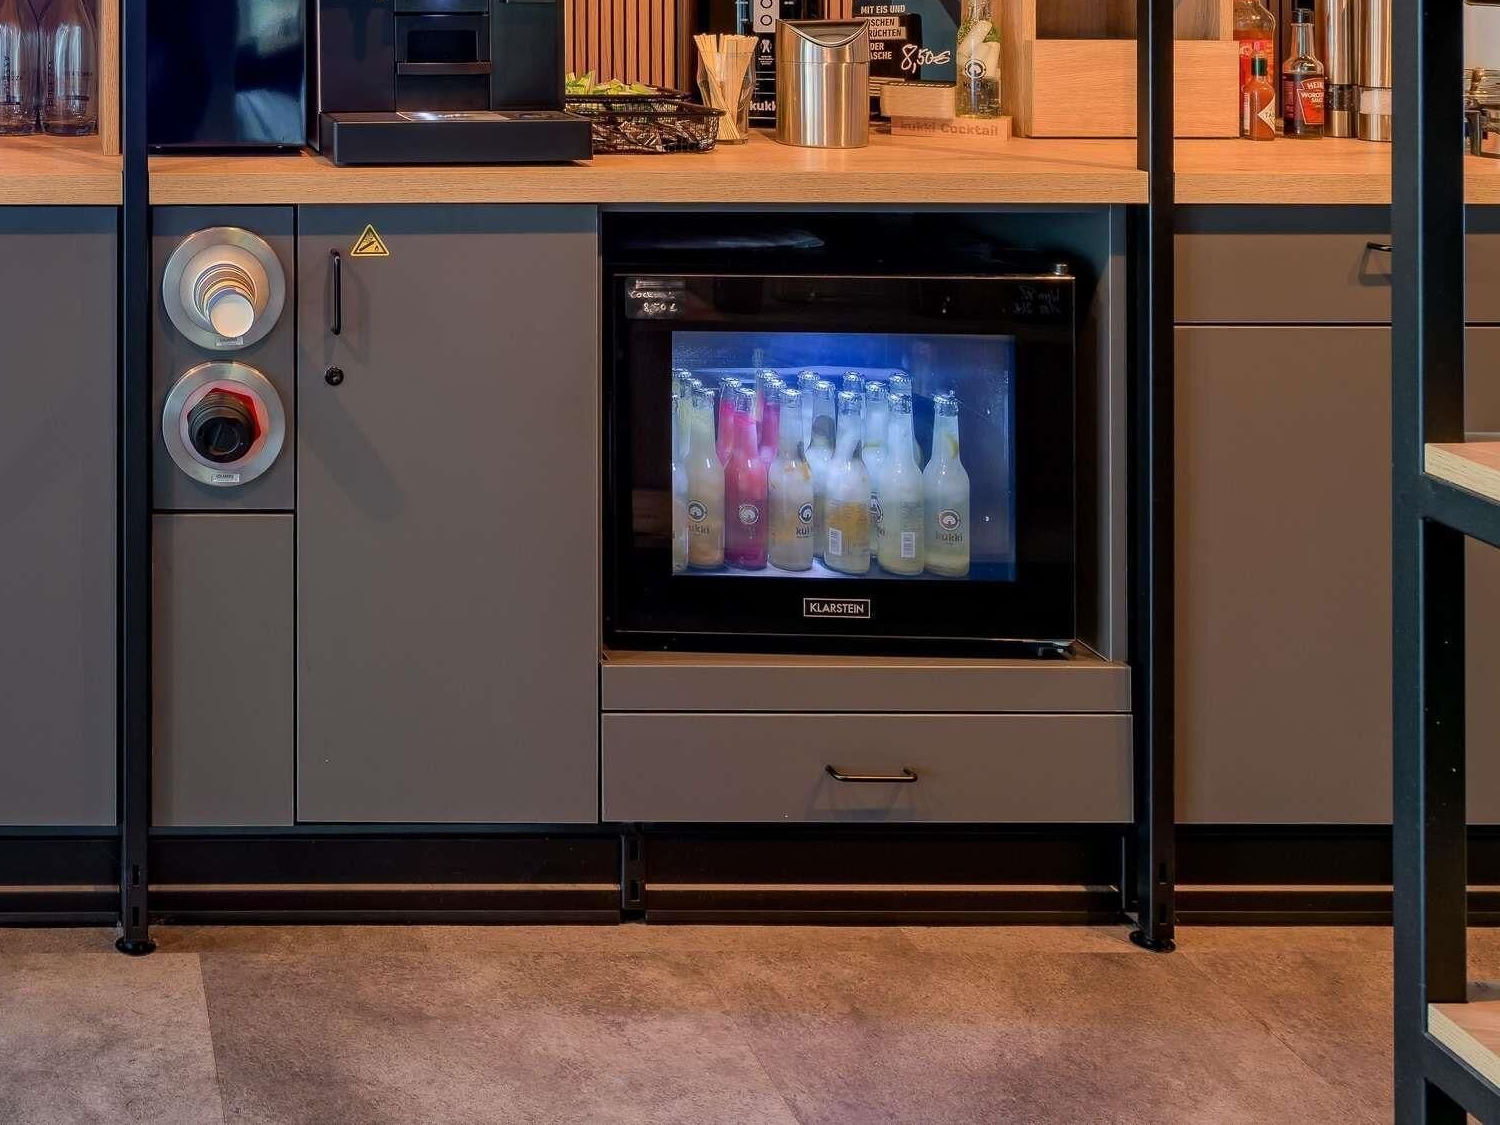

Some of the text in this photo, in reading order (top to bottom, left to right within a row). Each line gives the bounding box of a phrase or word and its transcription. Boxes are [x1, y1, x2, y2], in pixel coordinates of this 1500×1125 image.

[861, 4, 906, 14] MIT EIS UND
[870, 18, 895, 27] SCHEN
[868, 28, 902, 38] RÜCHTEN
[901, 43, 951, 74] 8,50€
[940, 121, 998, 136] Cocktail
[810, 602, 864, 614] KLARSTEIN
